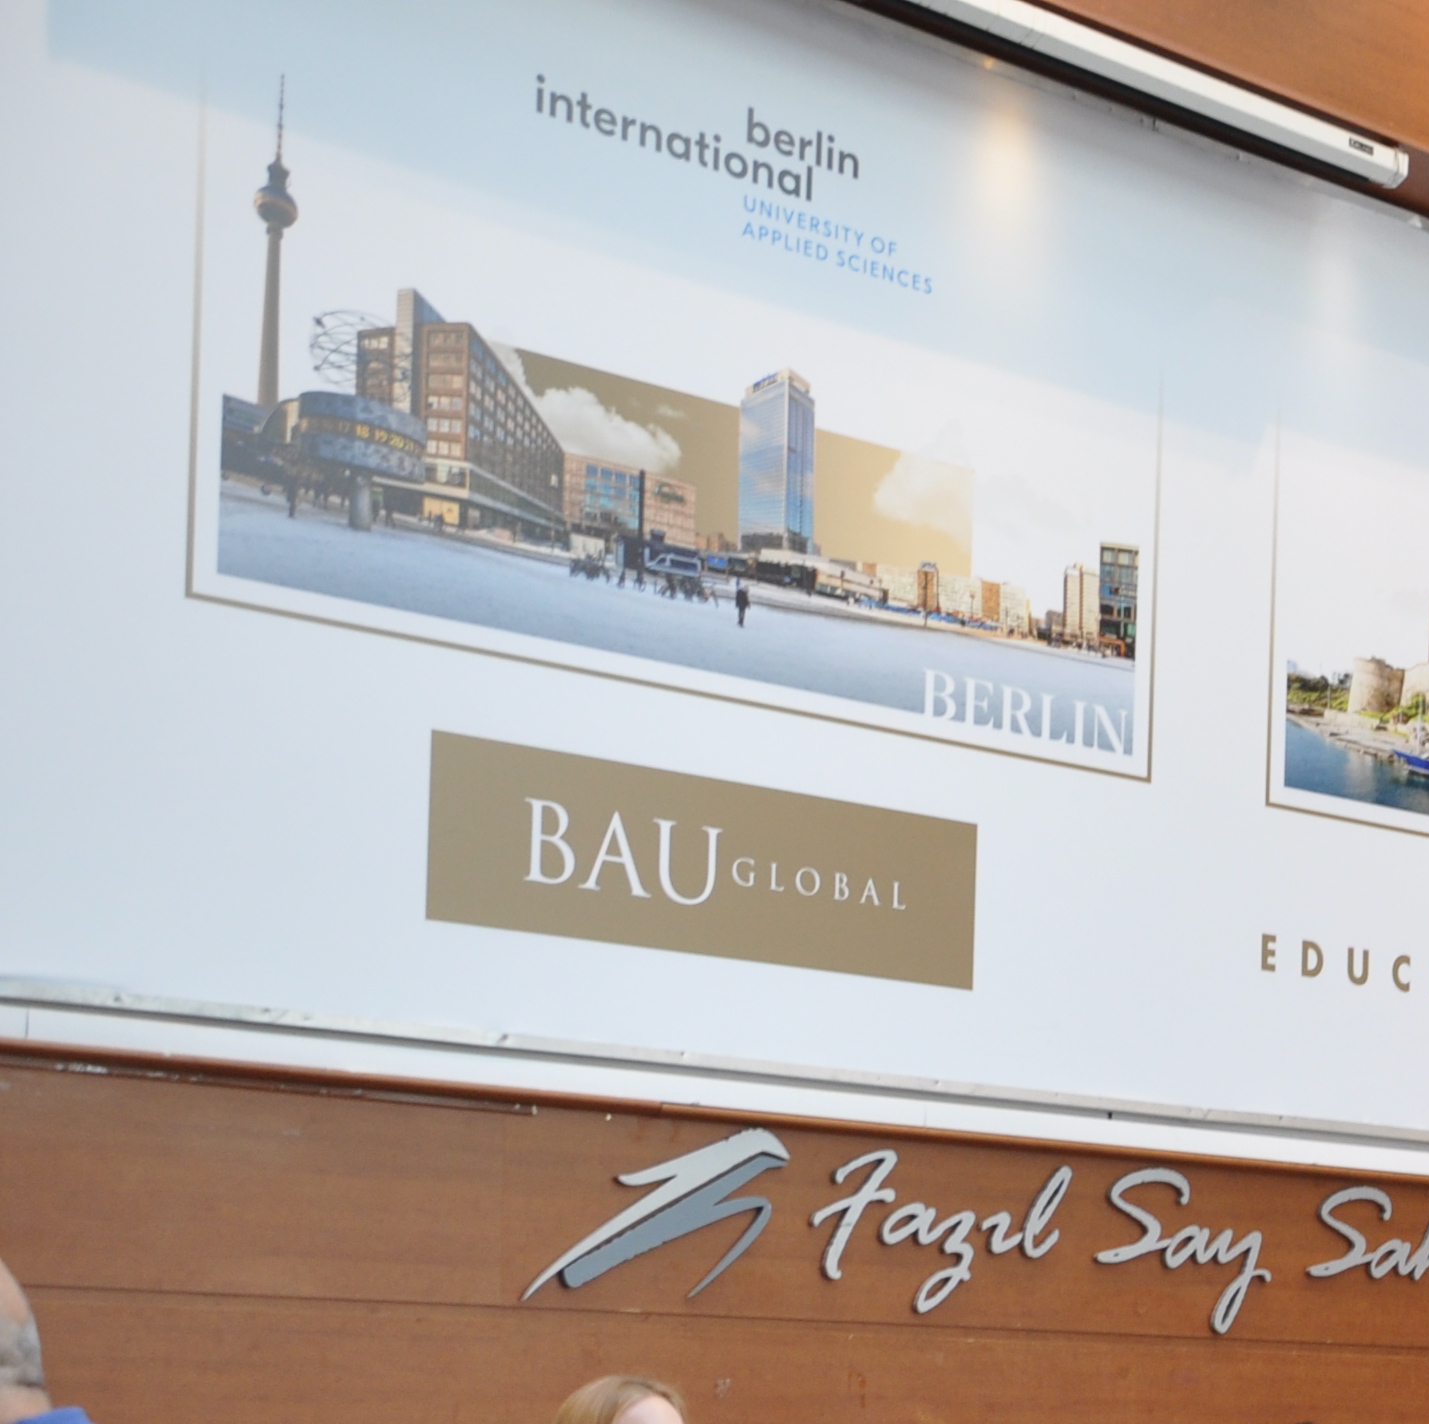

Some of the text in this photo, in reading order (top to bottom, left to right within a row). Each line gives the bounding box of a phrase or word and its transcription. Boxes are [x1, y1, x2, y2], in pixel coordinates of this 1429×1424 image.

[535, 73, 813, 201] international
[747, 107, 859, 179] berlin
[742, 222, 934, 296] APPLIED SCIENCES
[743, 194, 898, 257] UNIVERSITY OF
[922, 667, 1131, 757] BERLIN
[523, 796, 907, 911] BAU GLOBAL
[1092, 1167, 1272, 1336] Say
